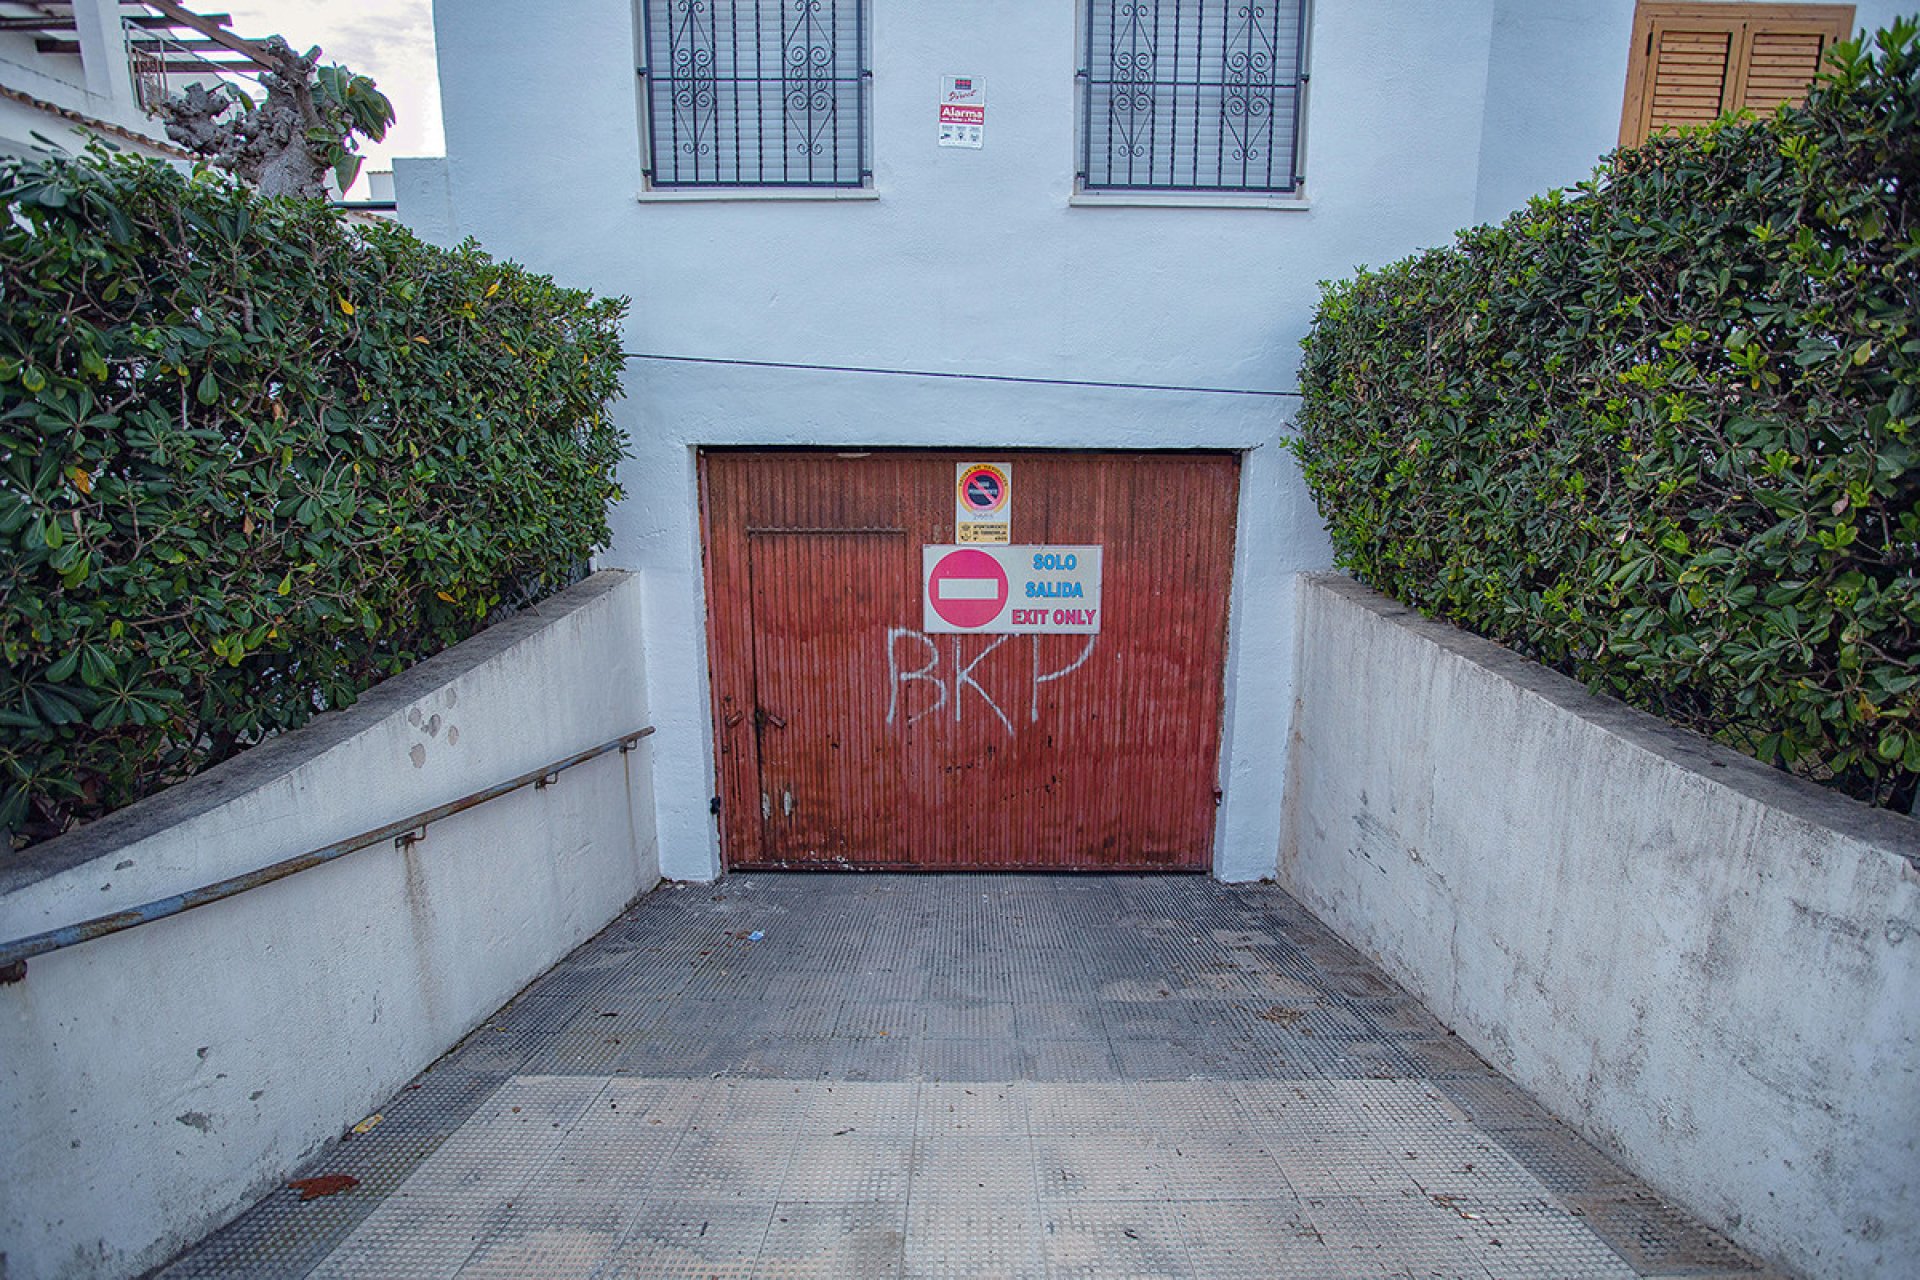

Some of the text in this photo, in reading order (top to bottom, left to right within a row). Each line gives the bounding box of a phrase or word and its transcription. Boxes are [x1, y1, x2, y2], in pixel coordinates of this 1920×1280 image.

[942, 107, 983, 118] Alarma
[1033, 553, 1077, 570] SOLO
[1025, 581, 1083, 598] SALIDA
[1011, 609, 1096, 625] EXIT ONLY
